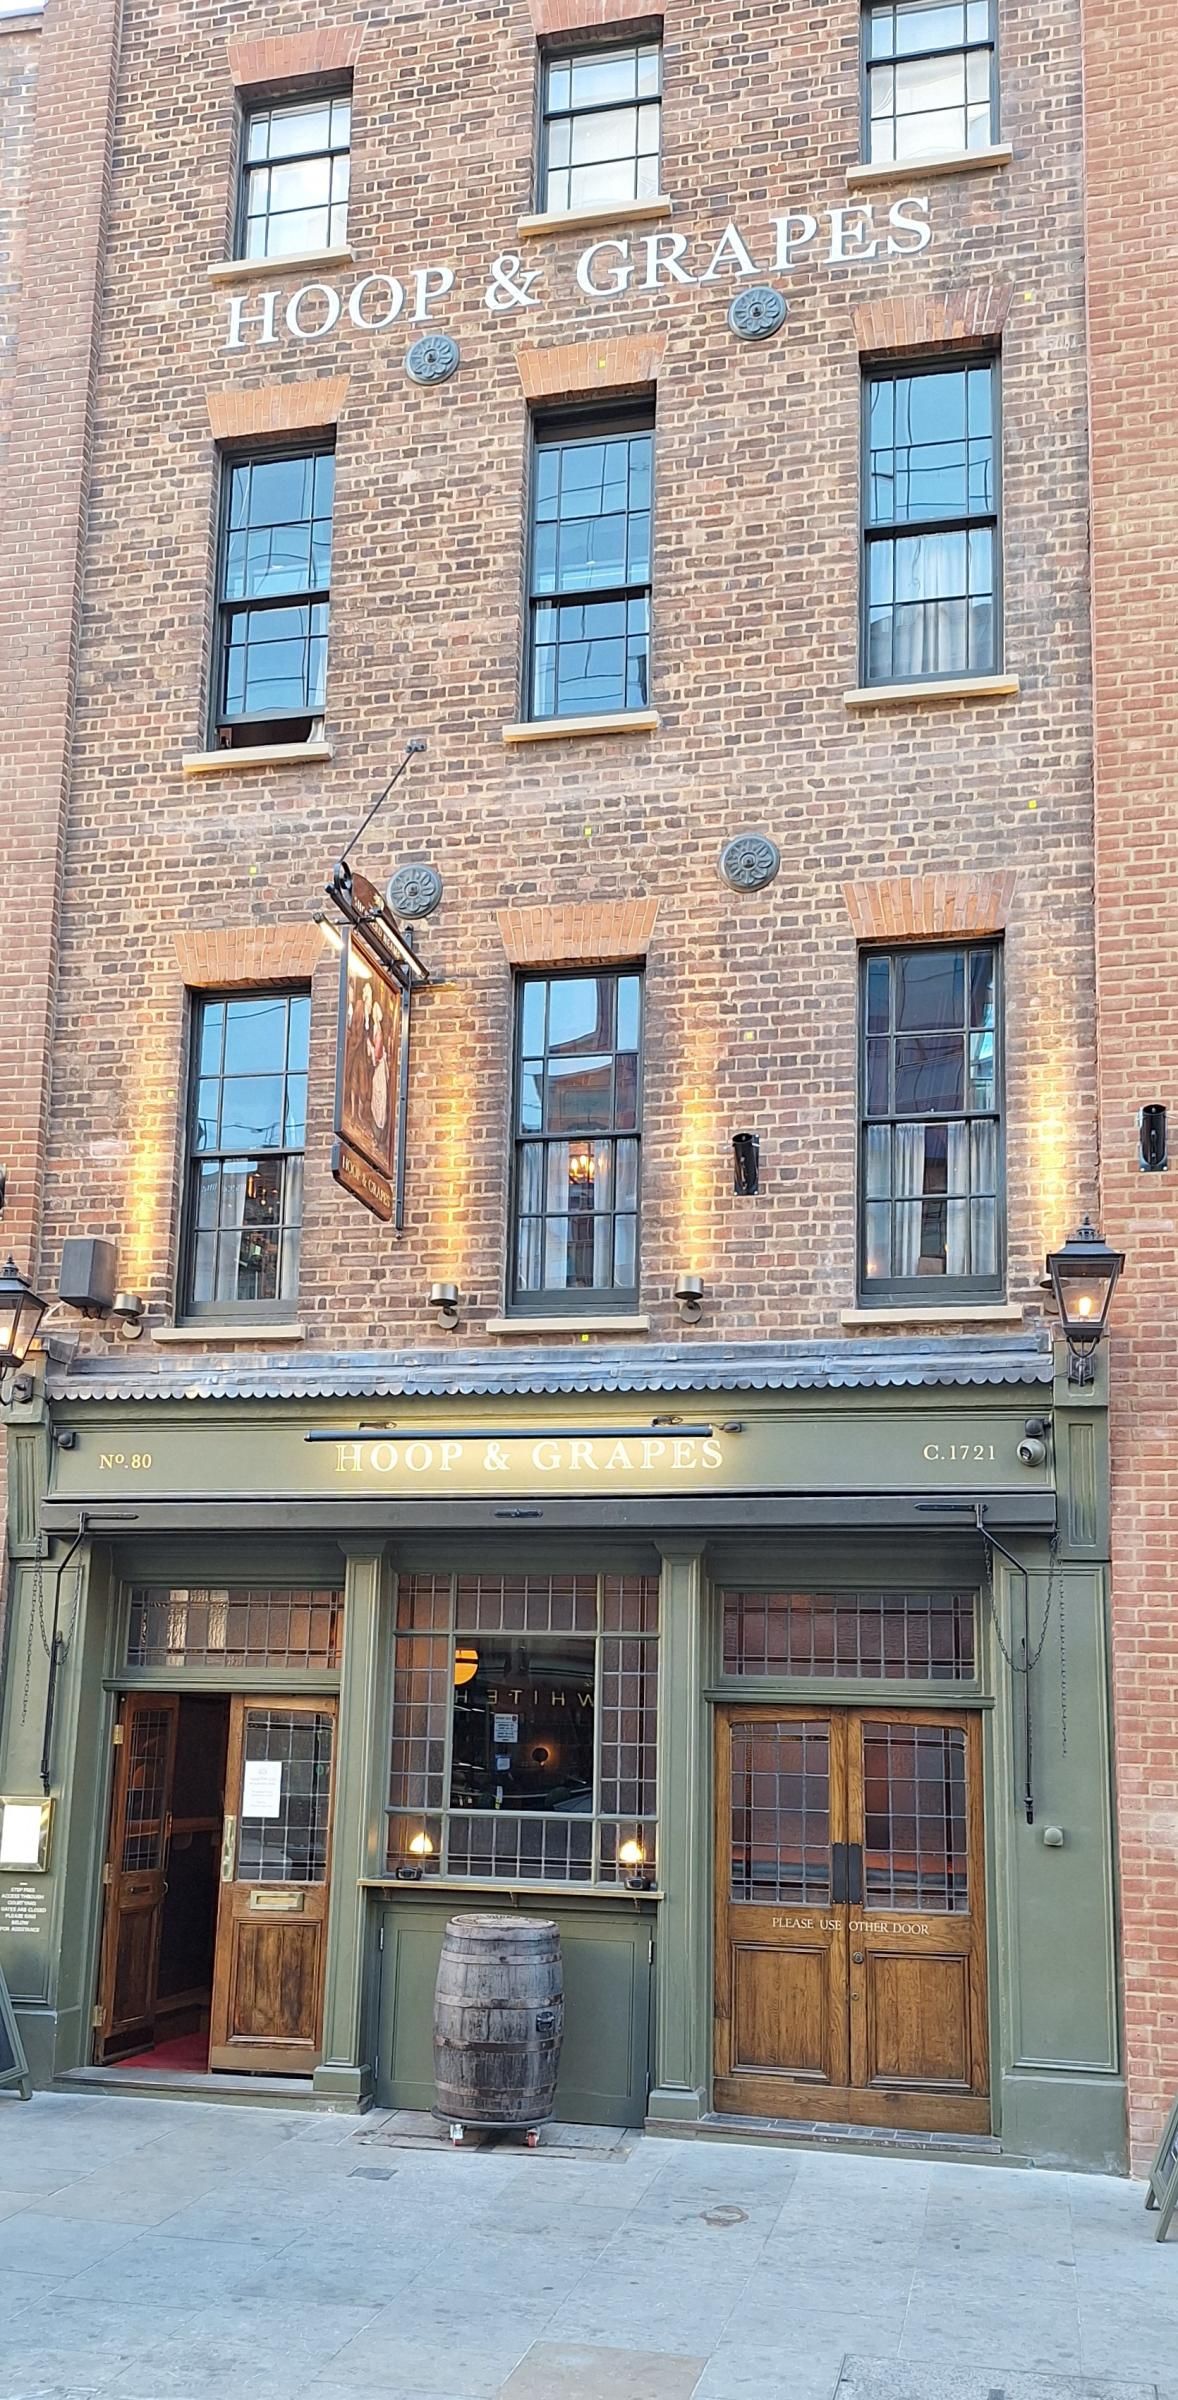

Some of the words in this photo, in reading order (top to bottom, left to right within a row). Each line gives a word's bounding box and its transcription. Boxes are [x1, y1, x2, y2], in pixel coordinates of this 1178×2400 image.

[223, 267, 454, 349] HOOP
[485, 255, 544, 311] &
[576, 197, 932, 297] GRAPES
[335, 1442, 463, 1472] HOOP
[483, 1441, 511, 1471] &
[532, 1438, 723, 1470] GRAPES
[923, 1444, 995, 1460] C.1721
[772, 1917, 814, 1929] PLEASE
[820, 1919, 842, 1930] USE
[849, 1920, 889, 1933] OTHER
[892, 1923, 929, 1935] DOOR
